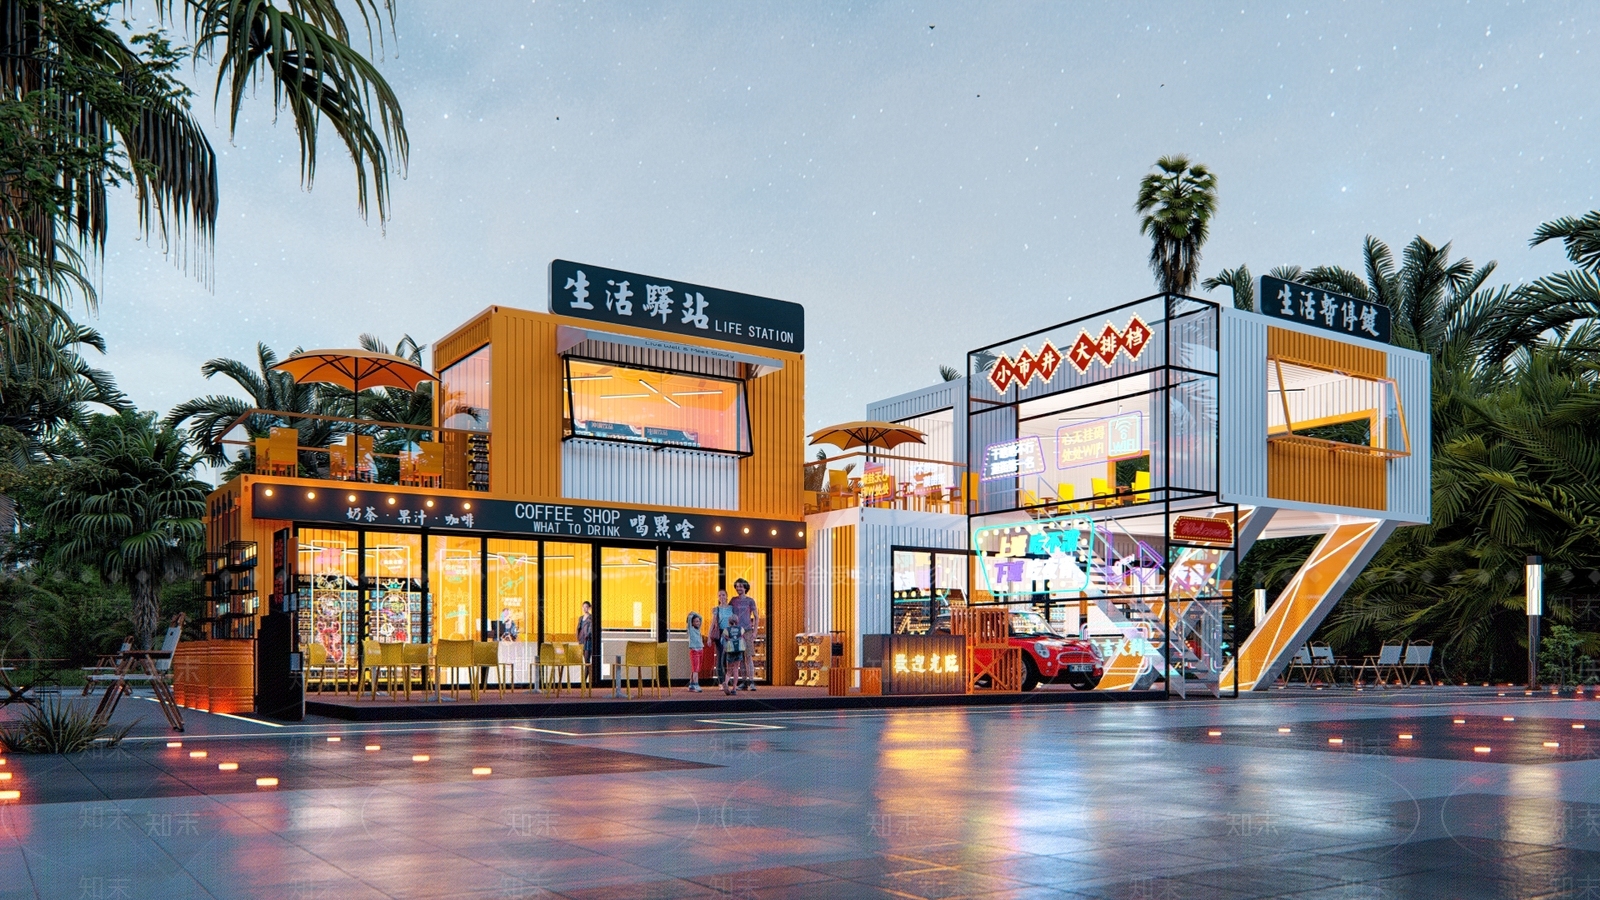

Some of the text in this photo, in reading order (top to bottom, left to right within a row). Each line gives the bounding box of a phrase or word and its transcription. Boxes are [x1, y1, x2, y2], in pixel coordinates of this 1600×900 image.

[564, 270, 709, 330] 生活驛站
[715, 319, 794, 344] LIFE STATION
[995, 327, 1144, 384] 小市井 大排档
[346, 506, 474, 528] 奶茶 果汁 咖啡
[515, 503, 621, 525] COFFEE SHOP
[629, 514, 695, 539] 喝點啥
[533, 521, 621, 537] WHAT TO DRINK
